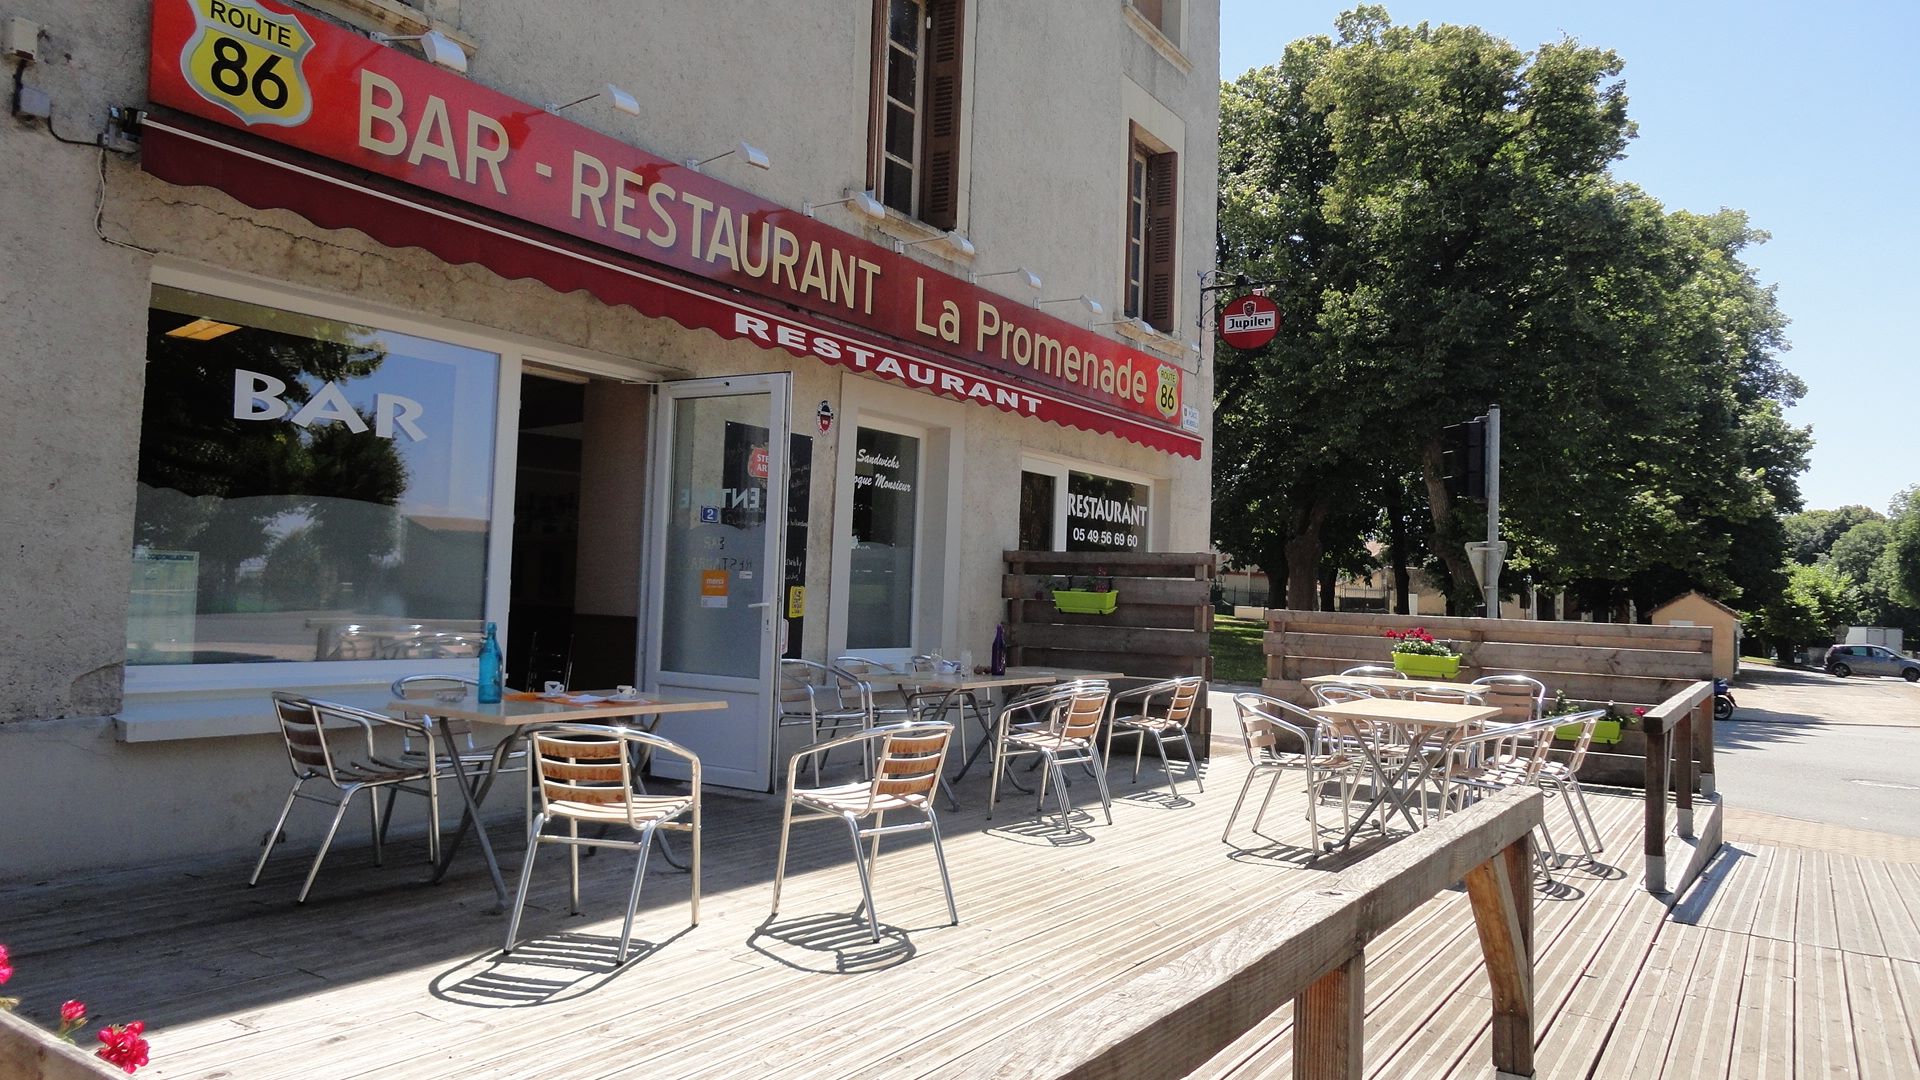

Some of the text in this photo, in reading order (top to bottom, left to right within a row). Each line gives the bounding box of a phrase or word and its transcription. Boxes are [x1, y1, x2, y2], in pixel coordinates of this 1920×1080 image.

[211, 0, 292, 49] ROUTE
[211, 37, 290, 110] 86
[359, 69, 508, 194] BAR
[571, 150, 881, 314] RESTAURANT
[1228, 316, 1272, 330] Jupiler
[915, 277, 1147, 404] La Promenade
[735, 312, 1042, 413] RESTAURANT
[1161, 370, 1176, 383] ROUTE
[234, 368, 428, 443] BAR
[1160, 384, 1175, 410] 86
[757, 453, 770, 463] STE
[856, 448, 901, 469] Sandwichs
[854, 473, 912, 493] oque Monsieur
[706, 508, 714, 520] 2
[1067, 492, 1148, 527] RESTAURANT
[1073, 527, 1138, 548] 05 49 56 69 60
